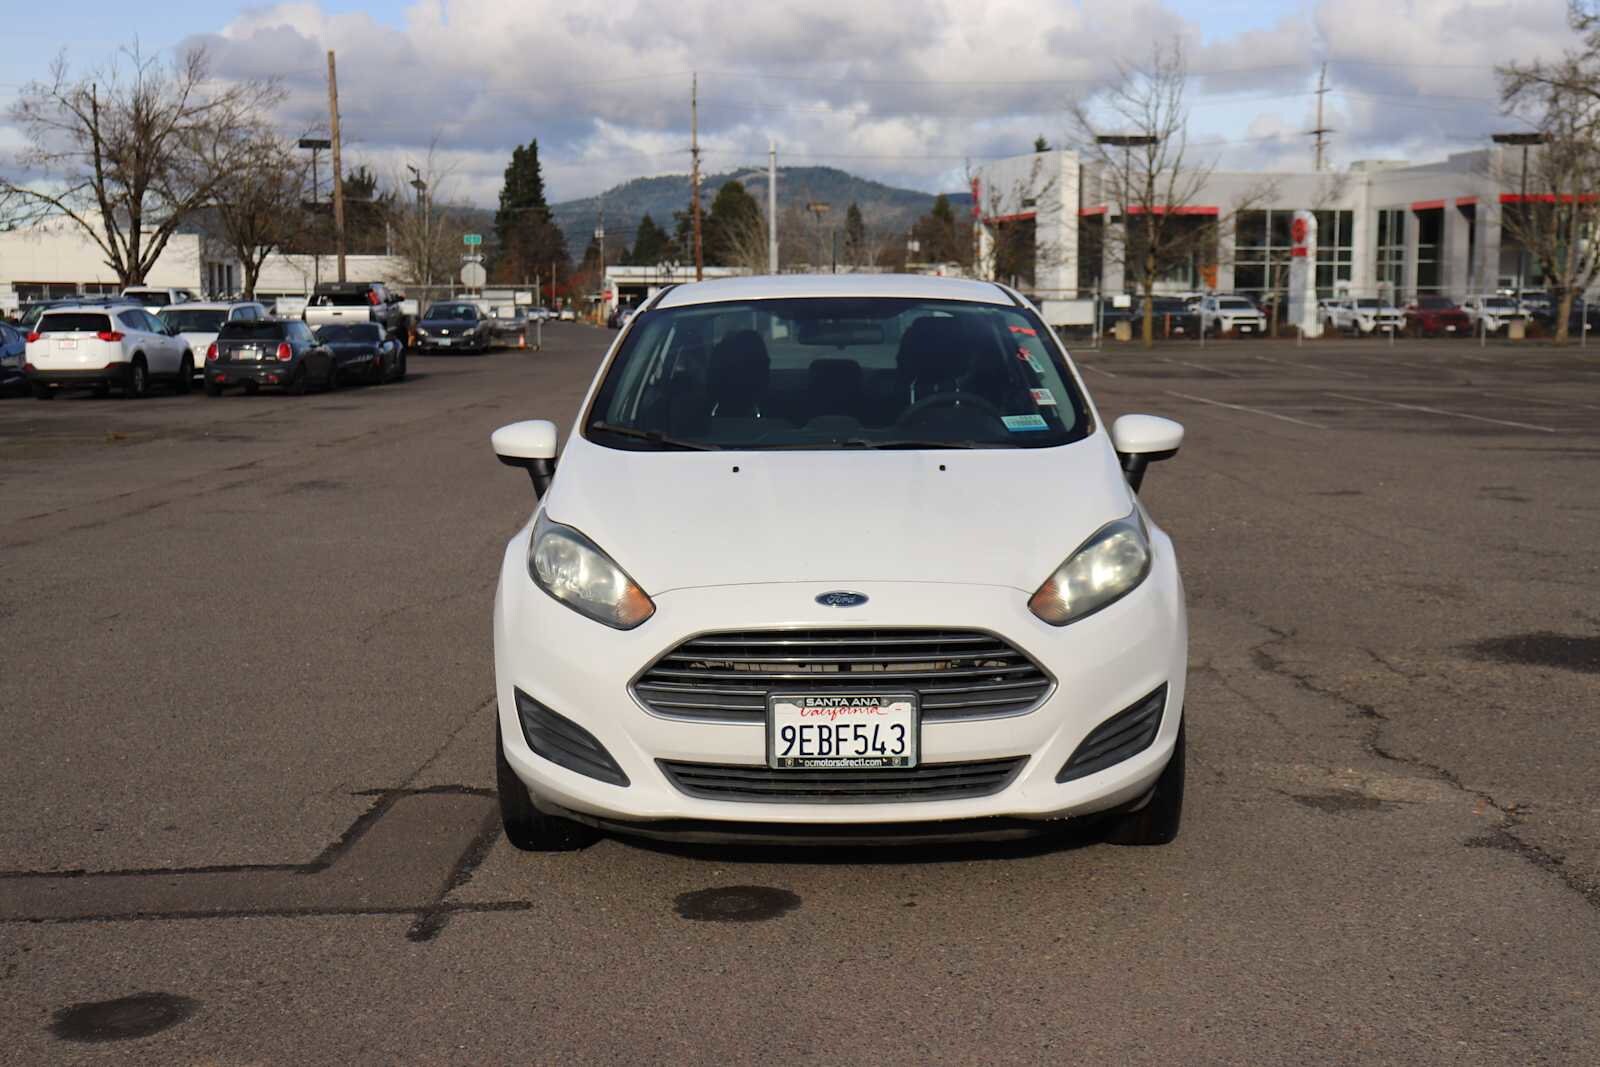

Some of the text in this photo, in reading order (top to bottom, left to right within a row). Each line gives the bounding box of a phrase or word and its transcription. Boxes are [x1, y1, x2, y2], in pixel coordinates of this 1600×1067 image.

[826, 593, 857, 604] Ford
[806, 698, 880, 706] SANTA ANA
[781, 723, 906, 756] 9EBF543
